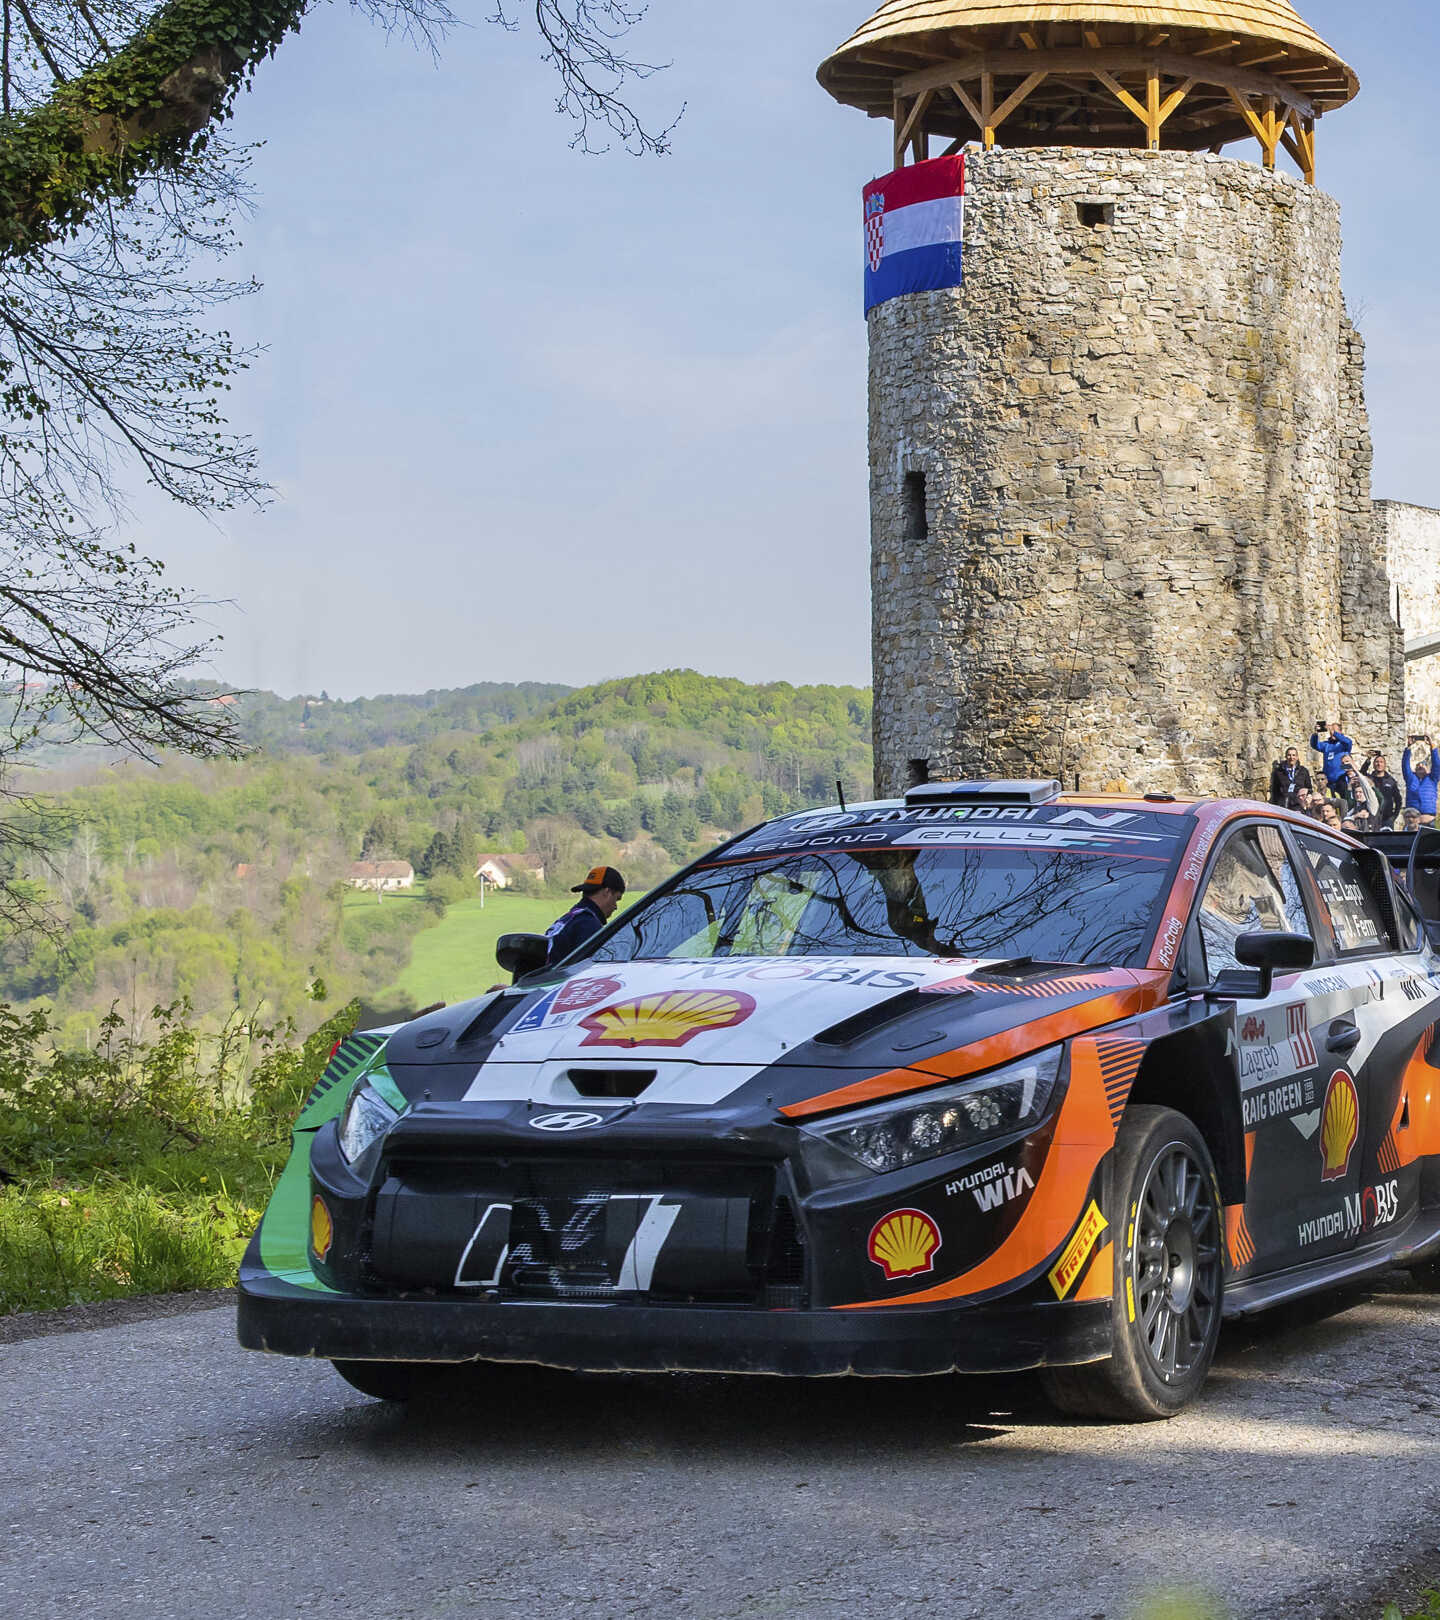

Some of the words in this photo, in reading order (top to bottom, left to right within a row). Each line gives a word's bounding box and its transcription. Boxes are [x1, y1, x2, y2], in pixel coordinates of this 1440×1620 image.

[865, 807, 1040, 823] HYUNDAI
[728, 833, 889, 856] BEYOND
[918, 830, 1053, 841] RALLY
[1337, 879, 1364, 906] Lappi
[1352, 914, 1378, 937] Ferm
[1158, 916, 1183, 969] #ForCraig
[676, 964, 926, 989] MOBIS
[1242, 1092, 1268, 1127] RAIG
[1268, 1081, 1302, 1119] BREEN
[945, 1161, 1006, 1196] HYUNDAI
[1297, 1210, 1344, 1247] HYUNDAI
[1343, 1179, 1399, 1239] MOBIS
[1055, 1211, 1097, 1288] PIRELLI
